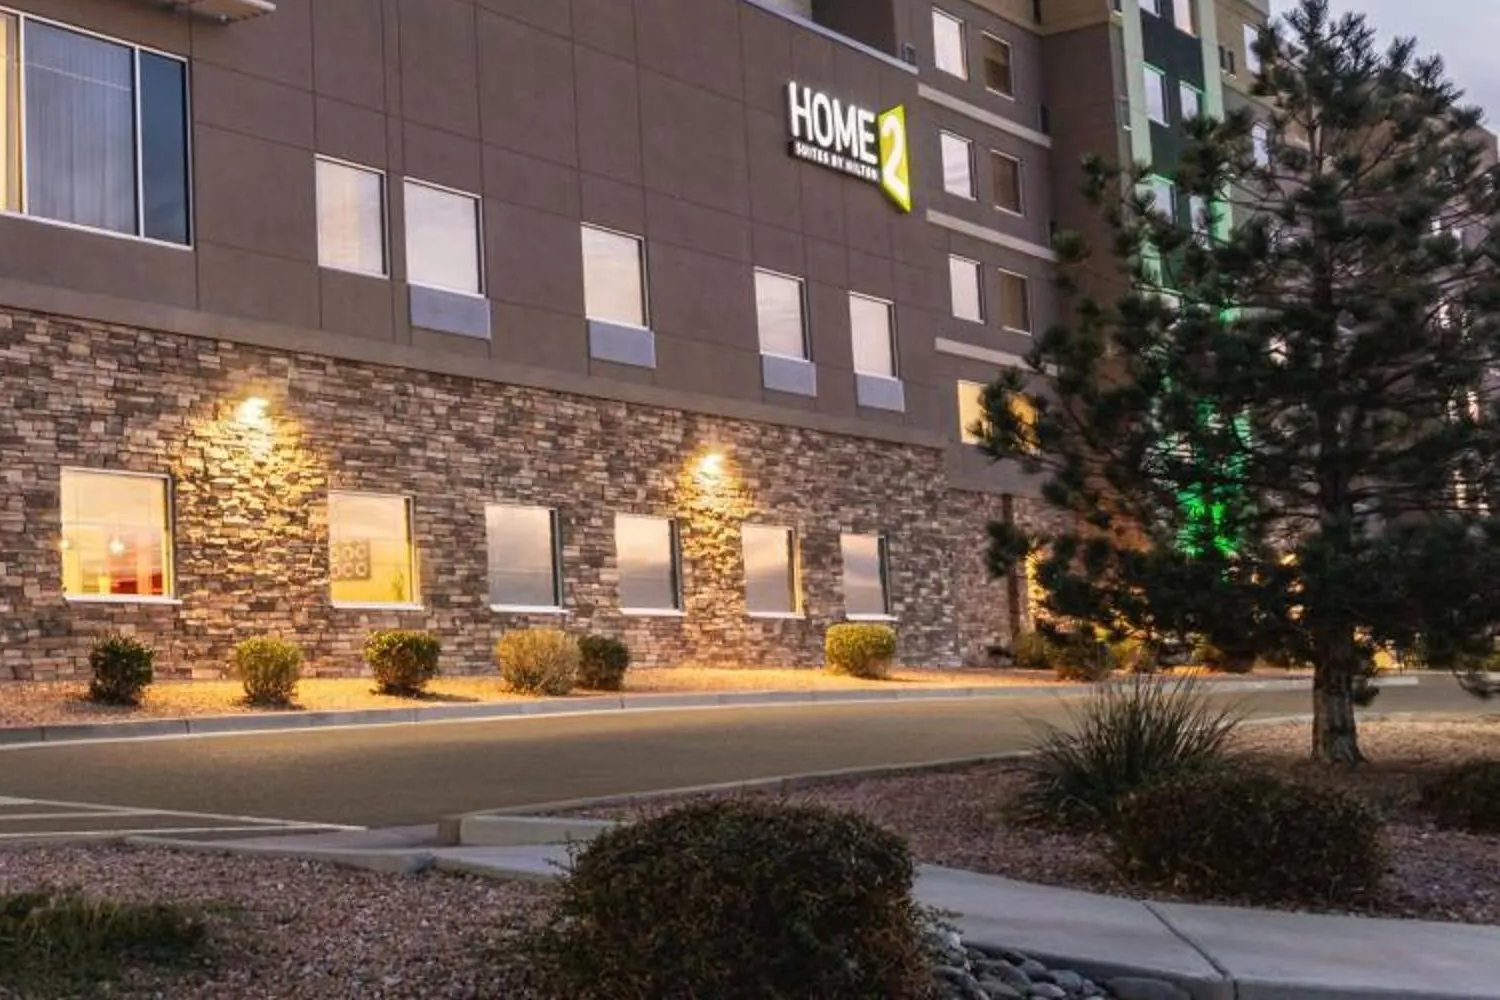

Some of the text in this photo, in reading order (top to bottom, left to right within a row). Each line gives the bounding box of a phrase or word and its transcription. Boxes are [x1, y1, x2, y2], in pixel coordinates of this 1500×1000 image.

[789, 80, 878, 164] HOME
[795, 141, 880, 182] SUITES BY HILTON
